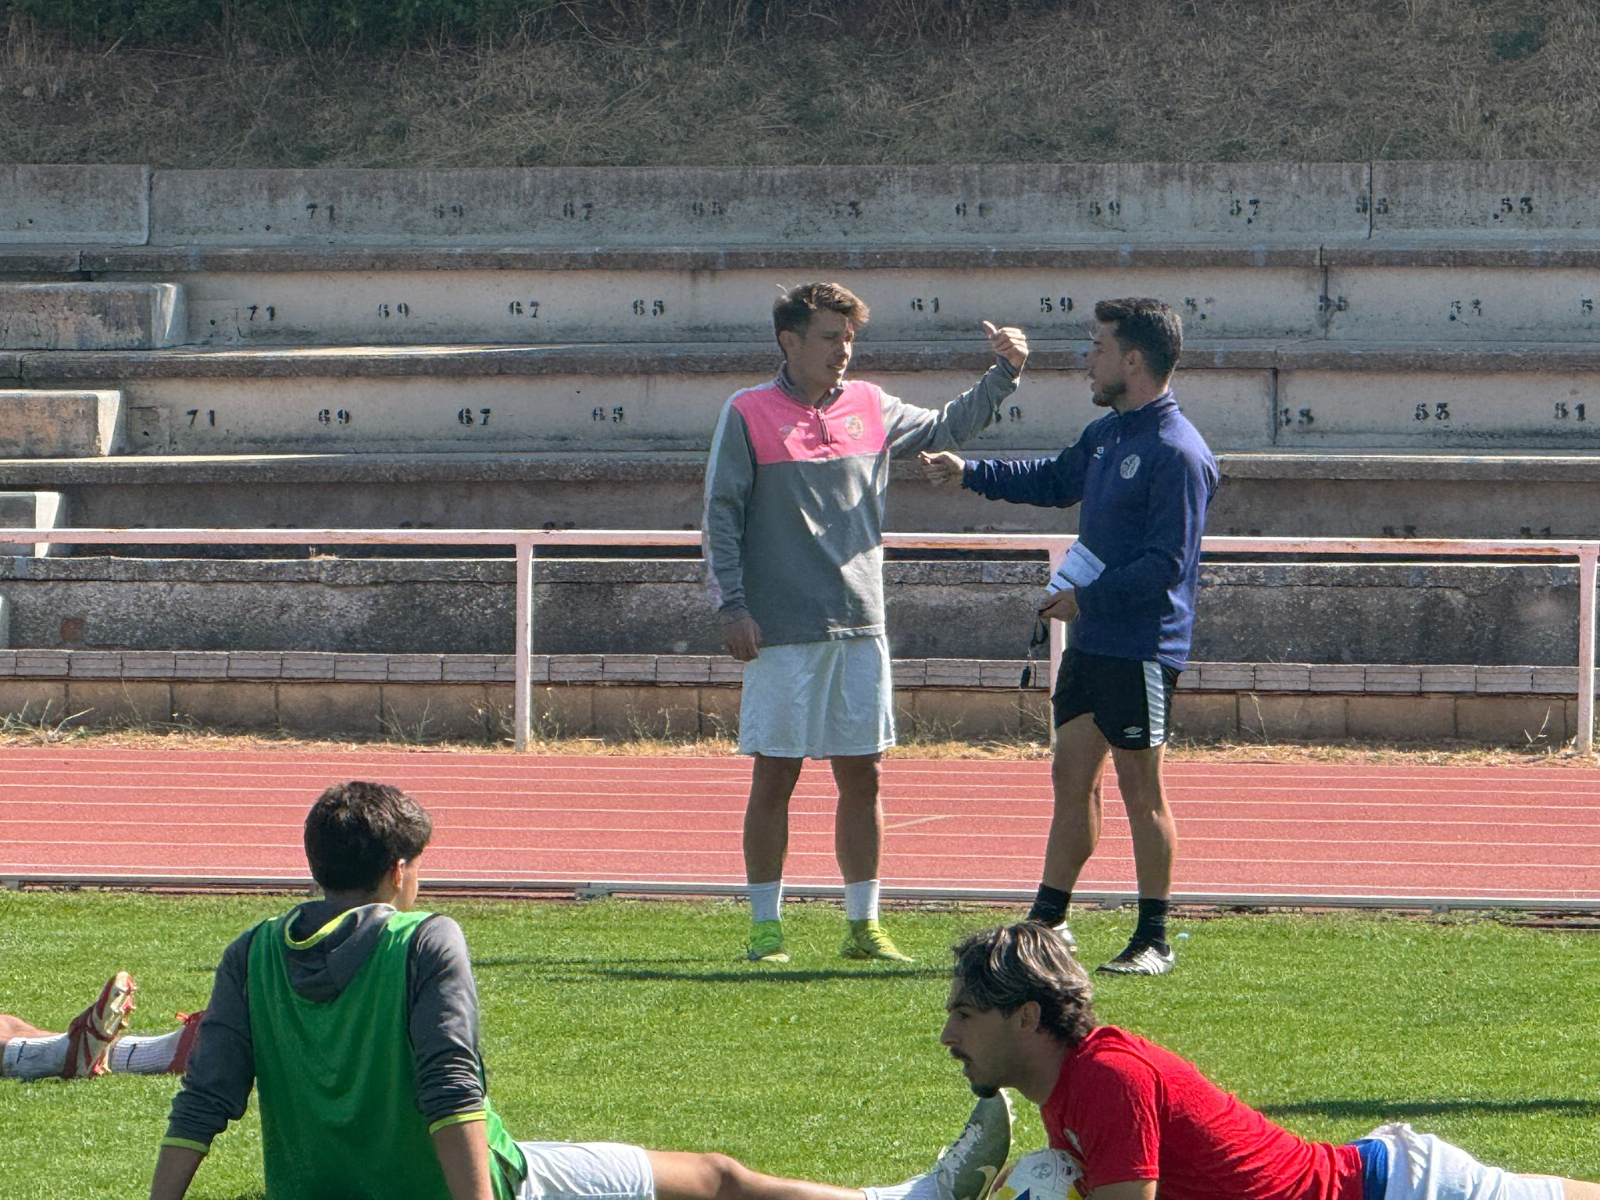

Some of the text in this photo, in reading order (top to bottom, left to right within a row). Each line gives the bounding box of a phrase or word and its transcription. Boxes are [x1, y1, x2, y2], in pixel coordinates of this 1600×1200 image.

[306, 202, 336, 222] 71
[1230, 199, 1260, 216] 57
[1500, 196, 1533, 214] 53
[247, 305, 276, 321] 71
[378, 302, 409, 318] 69
[508, 300, 540, 318] 67
[632, 300, 665, 316] 65
[911, 297, 939, 313] 61
[1040, 297, 1073, 312] 59
[186, 409, 215, 426] 71
[318, 409, 349, 425] 69
[458, 407, 491, 425] 67
[1414, 402, 1450, 421] 53
[1555, 403, 1587, 421] 51
